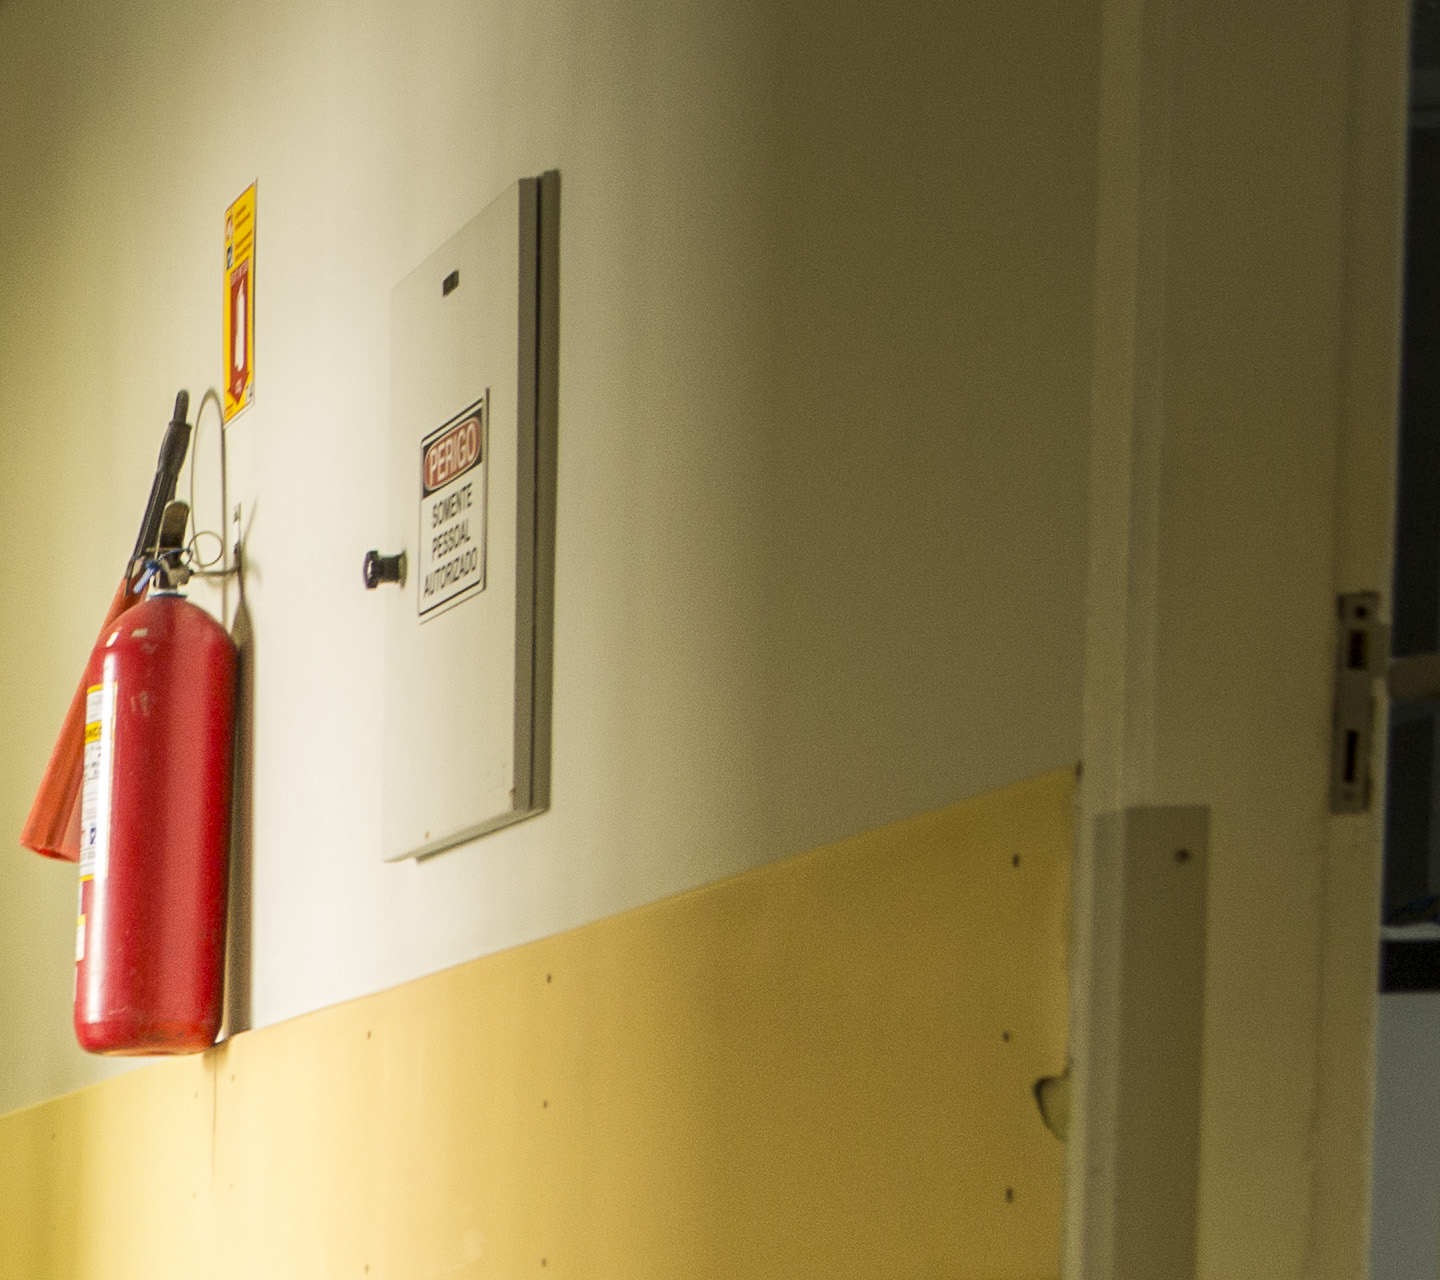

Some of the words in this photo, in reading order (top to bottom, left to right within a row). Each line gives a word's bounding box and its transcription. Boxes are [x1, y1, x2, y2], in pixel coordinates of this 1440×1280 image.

[430, 421, 477, 484] PERIGO
[432, 482, 473, 529] SOMENTE
[432, 518, 471, 561] PESSOAL
[424, 547, 478, 599] AUTORIZADO
